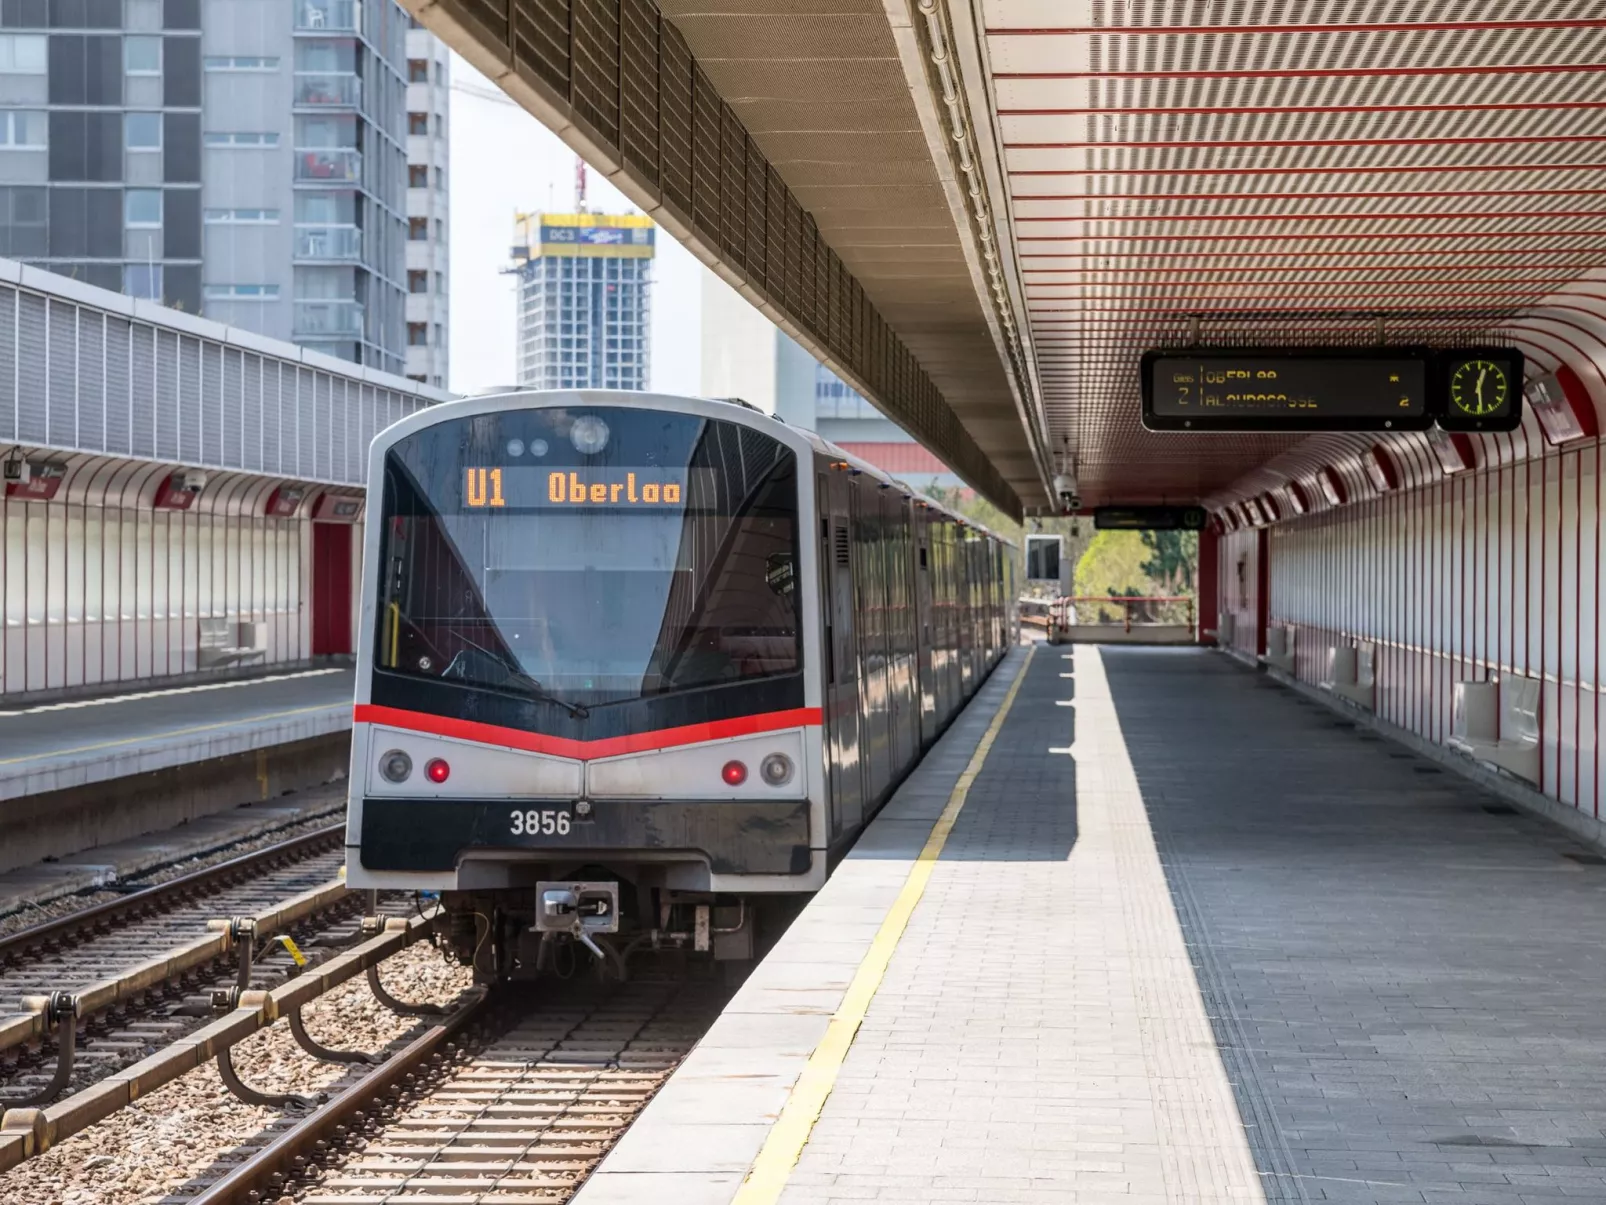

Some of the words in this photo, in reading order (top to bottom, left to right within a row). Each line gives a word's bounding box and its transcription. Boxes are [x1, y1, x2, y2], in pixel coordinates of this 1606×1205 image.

[467, 468, 505, 507] U1
[549, 472, 681, 503] Oberlaa
[510, 809, 571, 835] 3856
